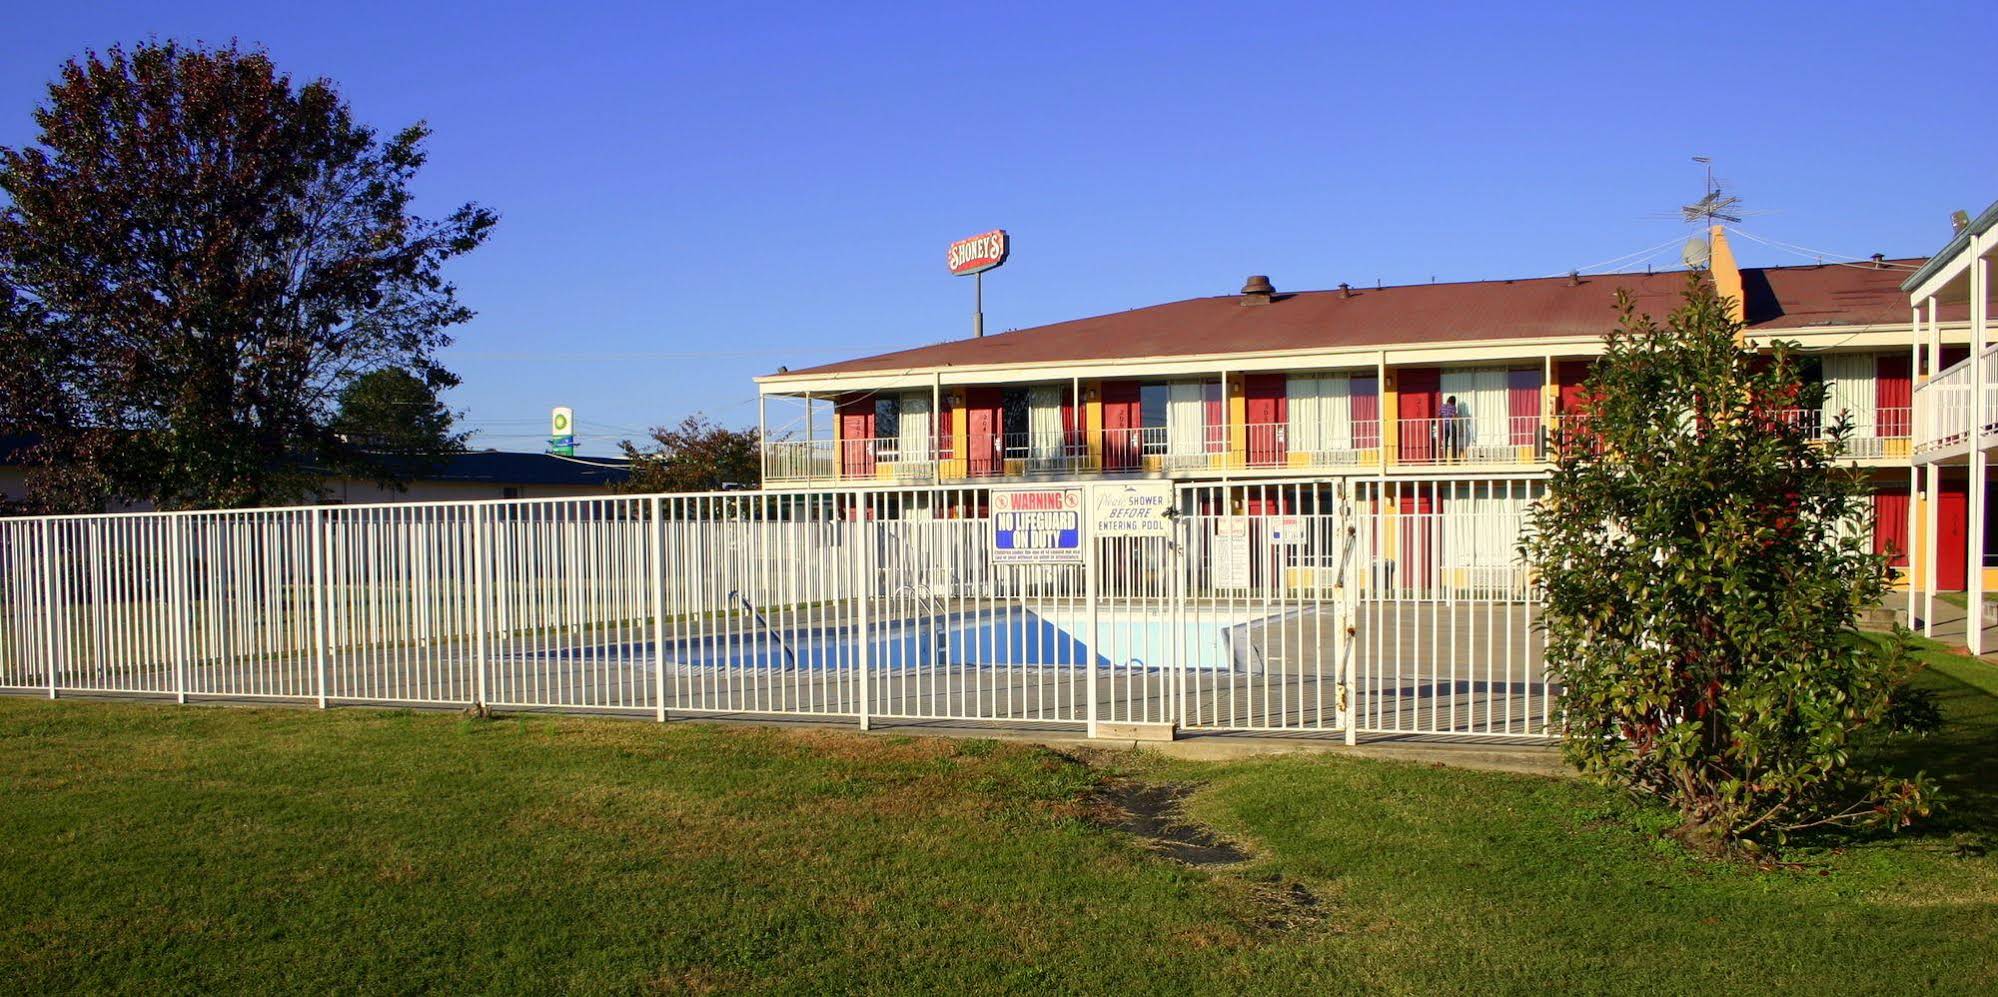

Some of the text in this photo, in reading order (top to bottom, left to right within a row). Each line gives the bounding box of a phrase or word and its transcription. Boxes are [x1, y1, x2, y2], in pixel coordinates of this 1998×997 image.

[1011, 492, 1063, 510] WARNING
[1129, 495, 1163, 506] SHOWER
[1109, 508, 1152, 519] BEFORE
[998, 511, 1076, 531] NO LIFEGUARD
[1098, 520, 1164, 531] ENTERING POOL
[1013, 530, 1061, 549] ON DUTY
